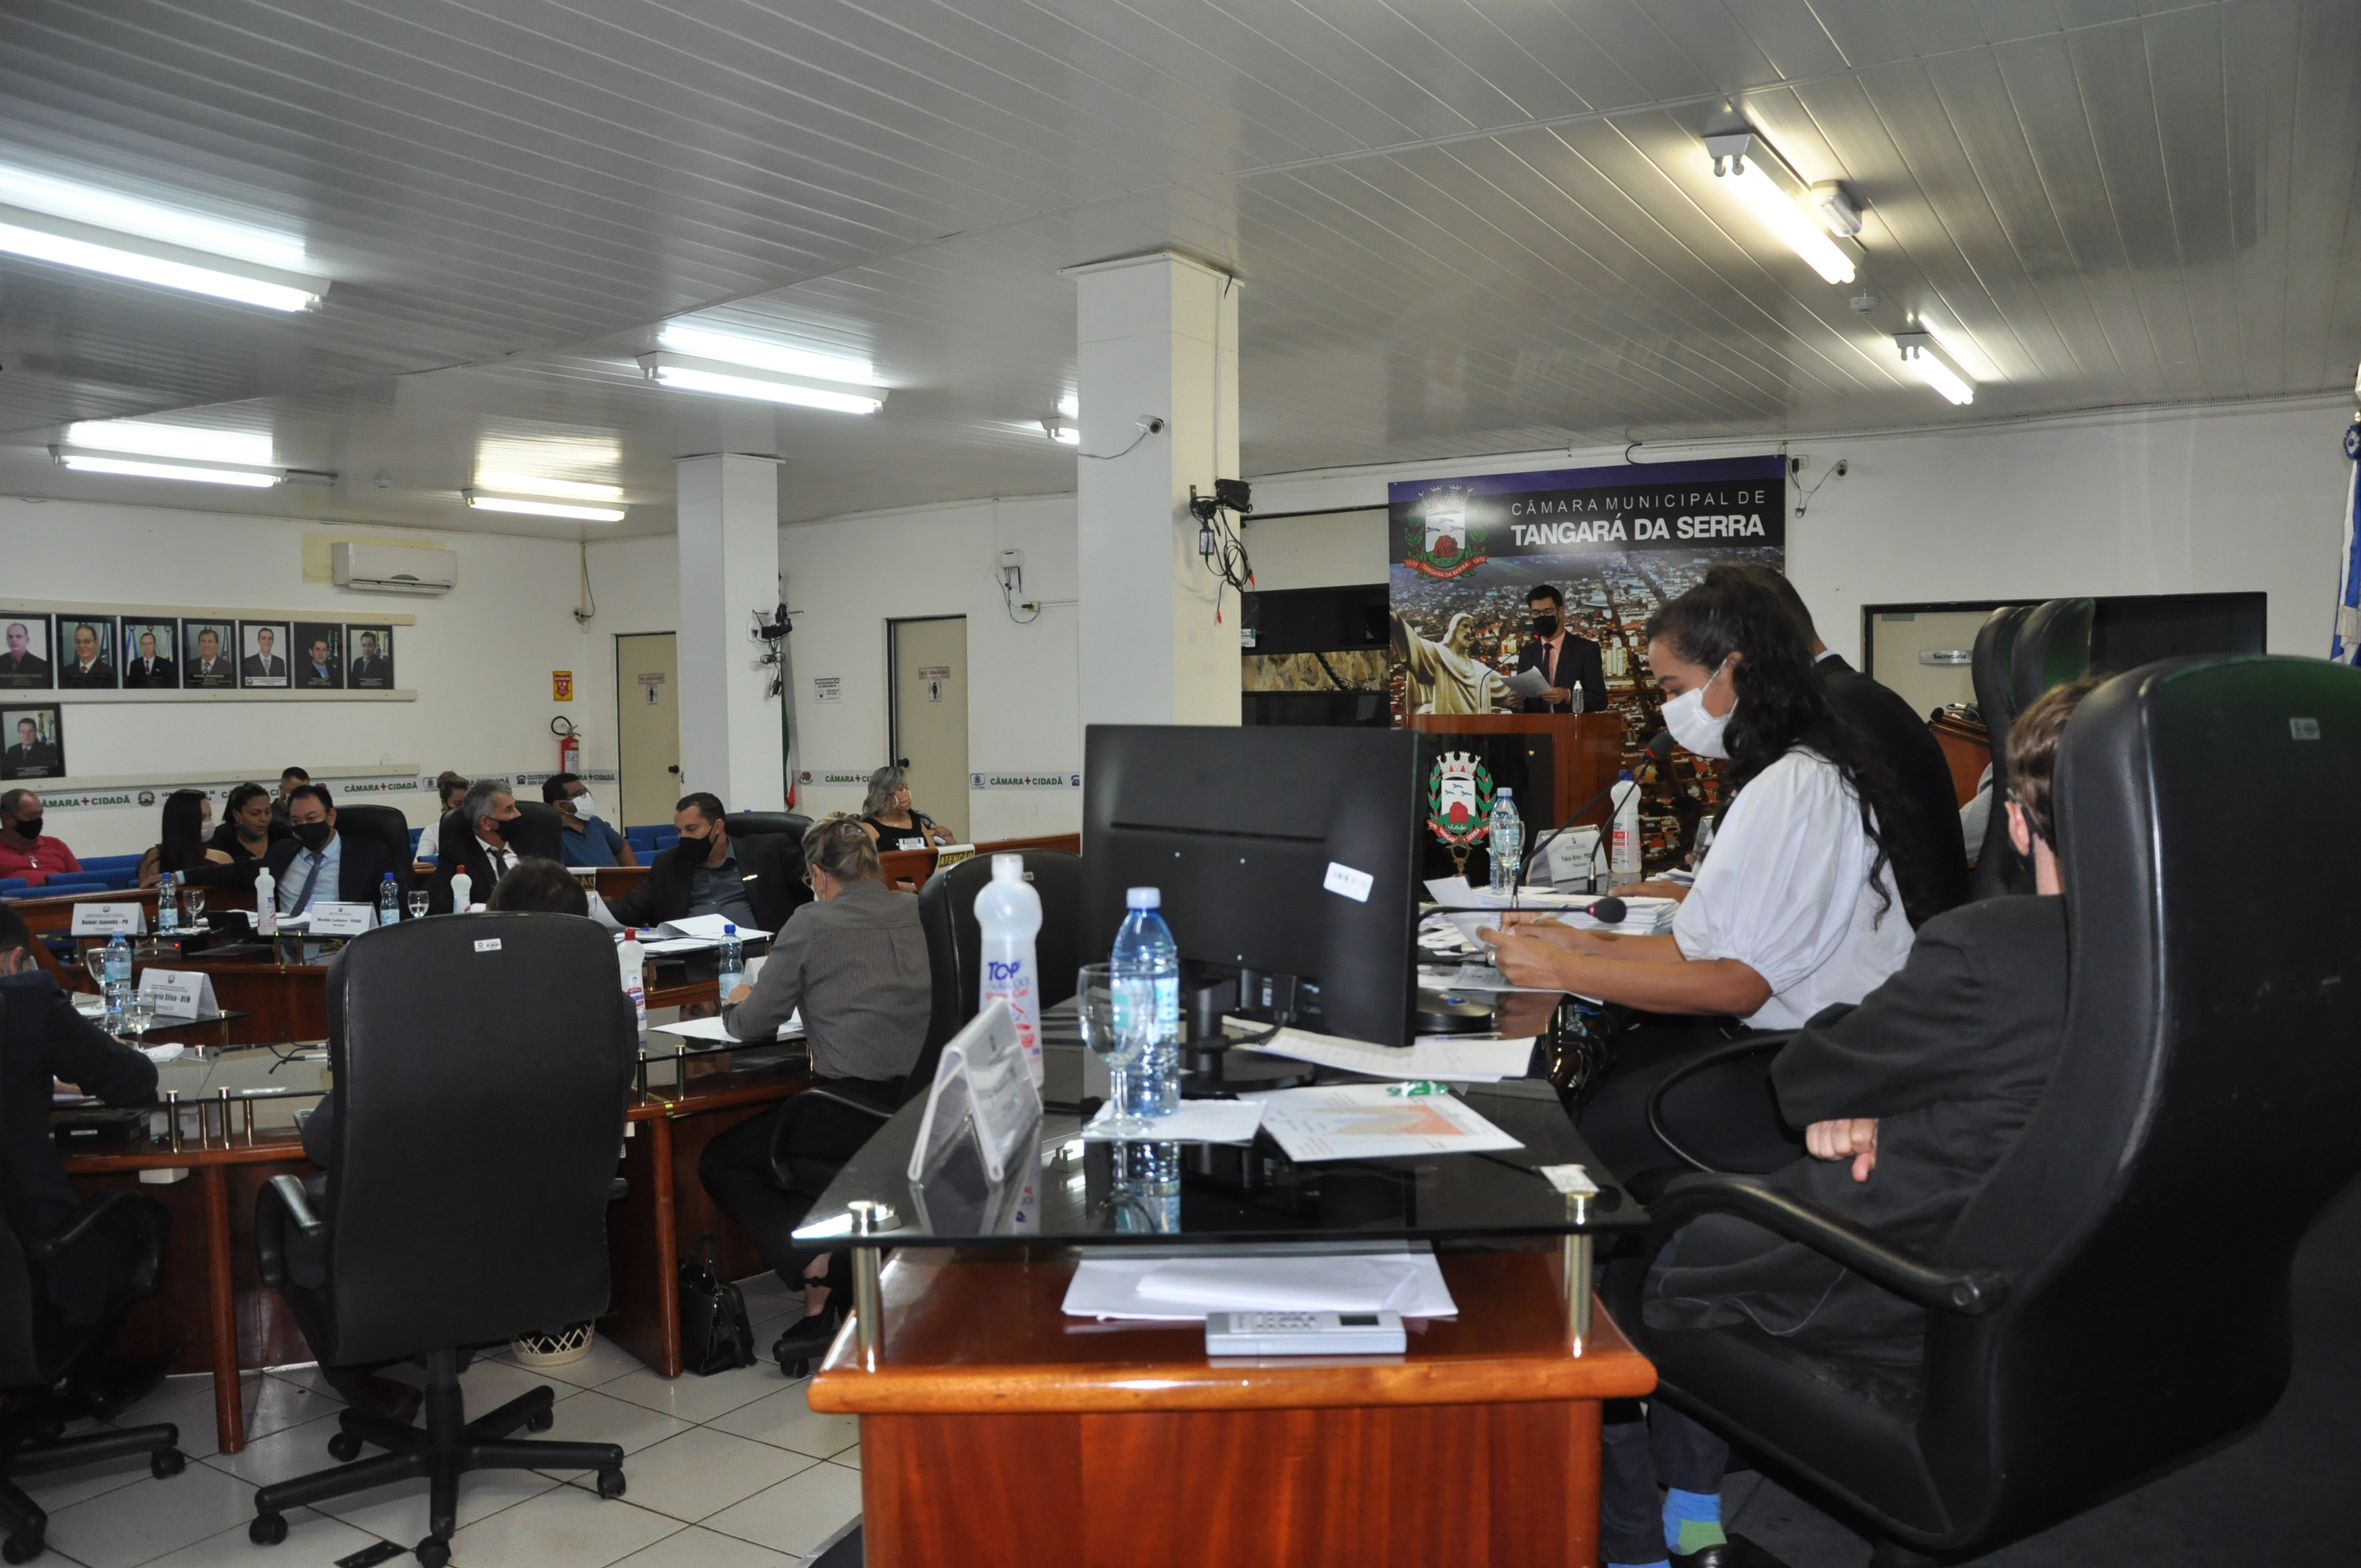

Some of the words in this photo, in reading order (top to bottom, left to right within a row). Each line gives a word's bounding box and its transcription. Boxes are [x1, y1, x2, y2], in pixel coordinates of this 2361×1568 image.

[1511, 498, 1598, 515] CÂMARA
[1606, 493, 1729, 510] MUNICIPAL
[1738, 491, 1765, 504] DE
[1511, 513, 1628, 546] TANGARÁ
[1634, 518, 1671, 541] DA
[1677, 514, 1765, 539] SERRA
[1452, 562, 1470, 576] SERRA
[1466, 827, 1481, 841] SERRA
